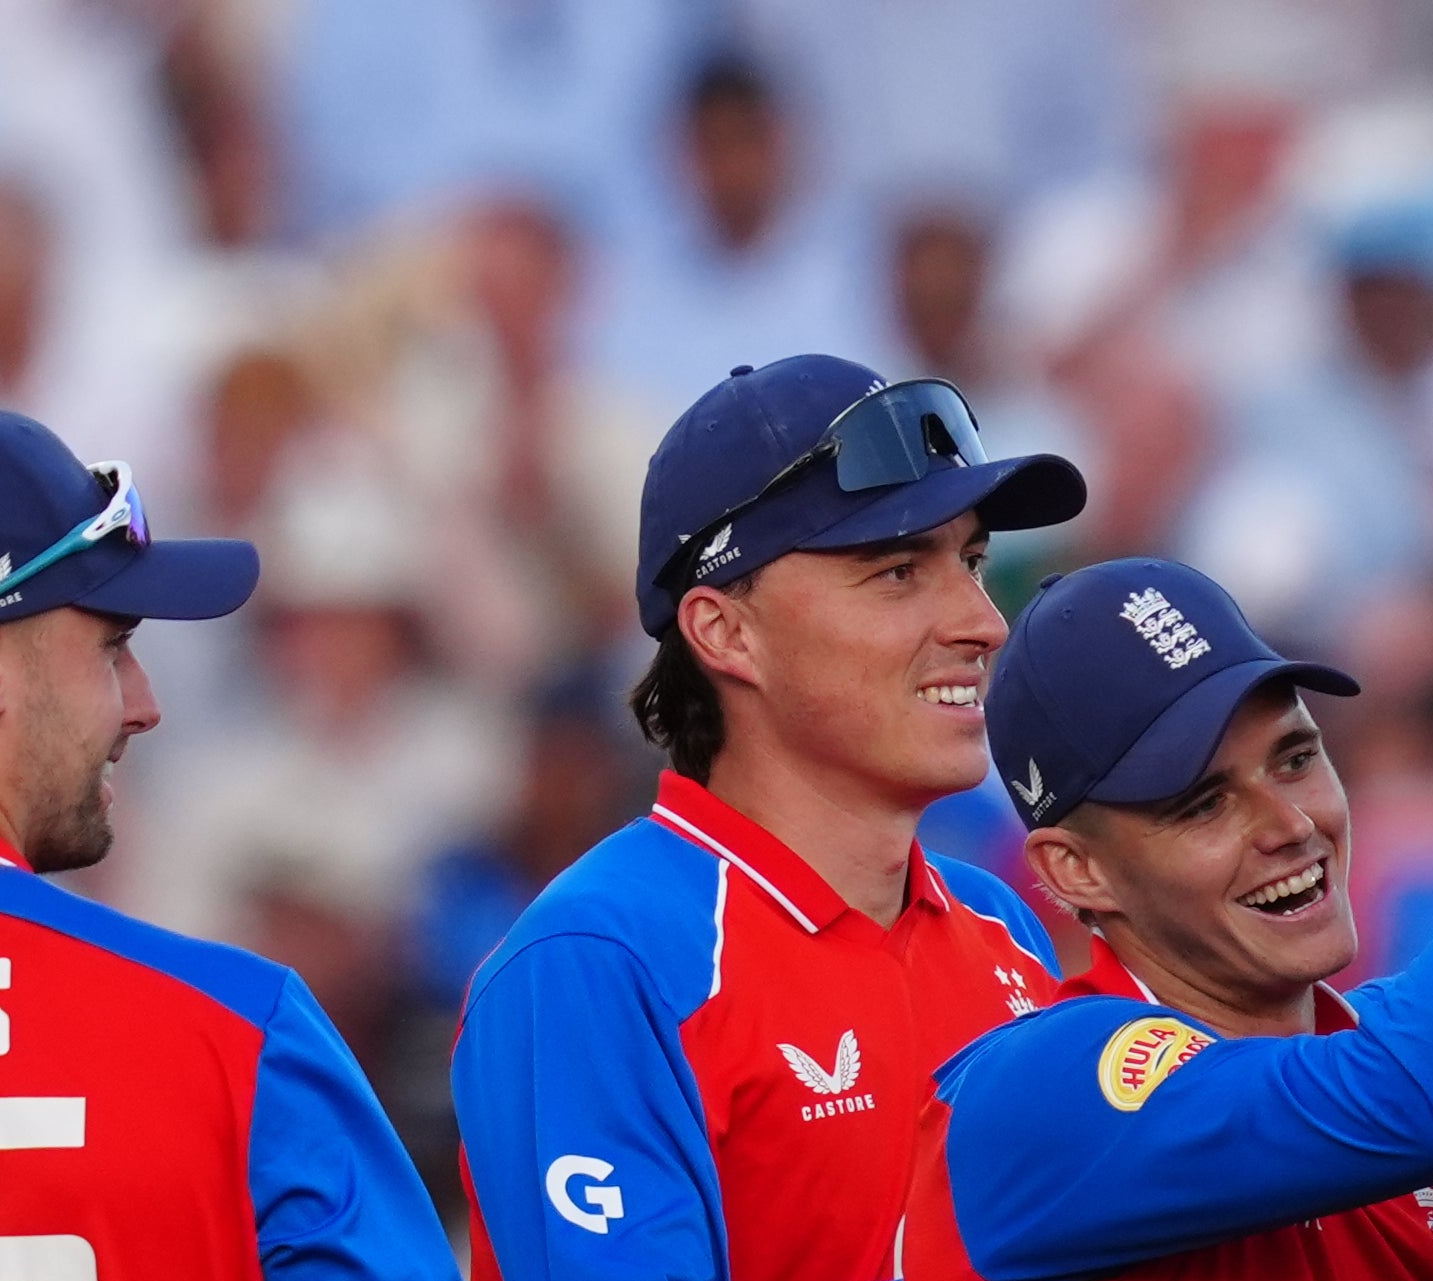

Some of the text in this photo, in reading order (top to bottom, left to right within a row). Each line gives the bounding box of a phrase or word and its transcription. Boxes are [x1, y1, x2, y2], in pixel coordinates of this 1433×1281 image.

[695, 546, 742, 579] CASTORE
[1121, 1028, 1176, 1090] HULA
[801, 1094, 876, 1122] CASTORE
[546, 1154, 625, 1235] G
